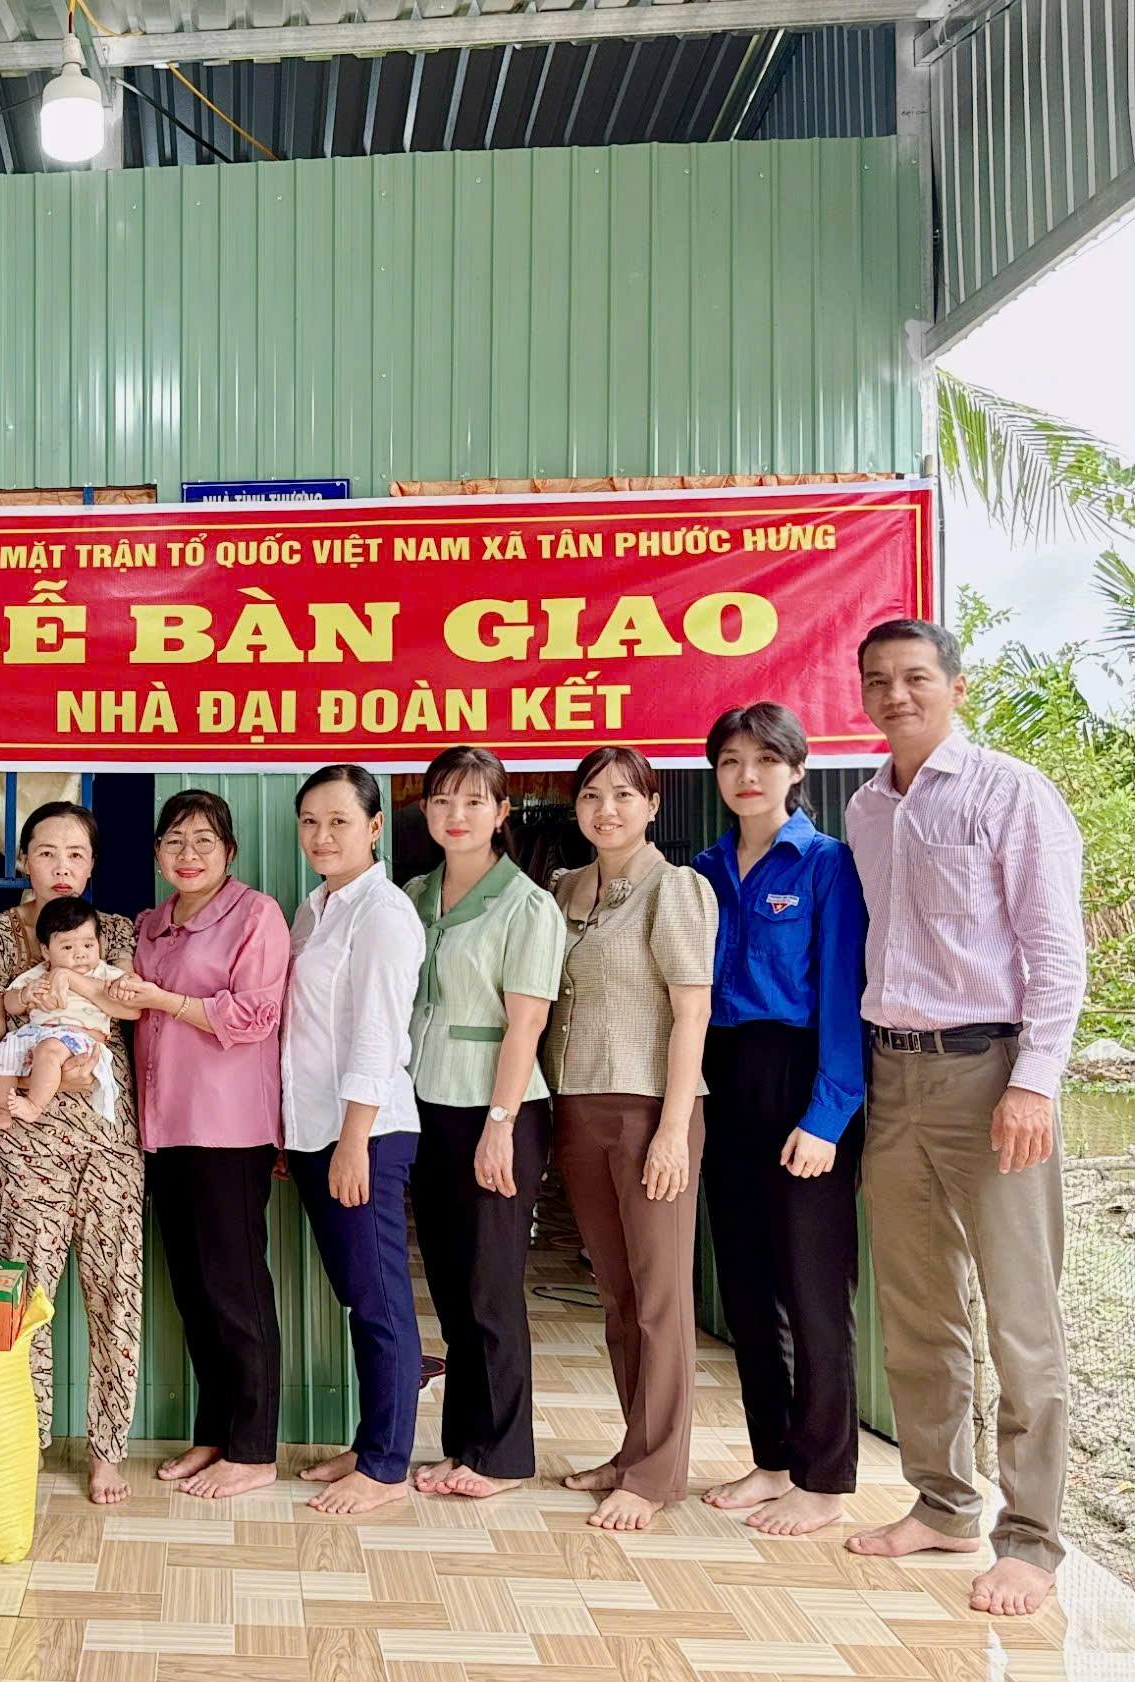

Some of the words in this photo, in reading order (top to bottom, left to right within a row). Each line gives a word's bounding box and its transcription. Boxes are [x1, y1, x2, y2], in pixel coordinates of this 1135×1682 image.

[0, 540, 66, 573] MẶT
[75, 538, 156, 573] TRẬN
[167, 532, 208, 567] TỔ
[216, 532, 301, 568] QUỐC
[312, 533, 383, 568] VIỆT
[393, 536, 470, 561] NAM
[481, 530, 527, 560] XÃ
[537, 529, 603, 559] TÂN
[615, 524, 731, 557] PHƯỚC
[743, 522, 836, 552] HƯNG
[129, 586, 400, 664] BÀN
[443, 591, 778, 663] GIAO
[56, 681, 179, 733] NHÀ
[196, 690, 296, 743] ĐẠI
[317, 680, 487, 733] ĐOÀN
[511, 671, 631, 731] KẾT
